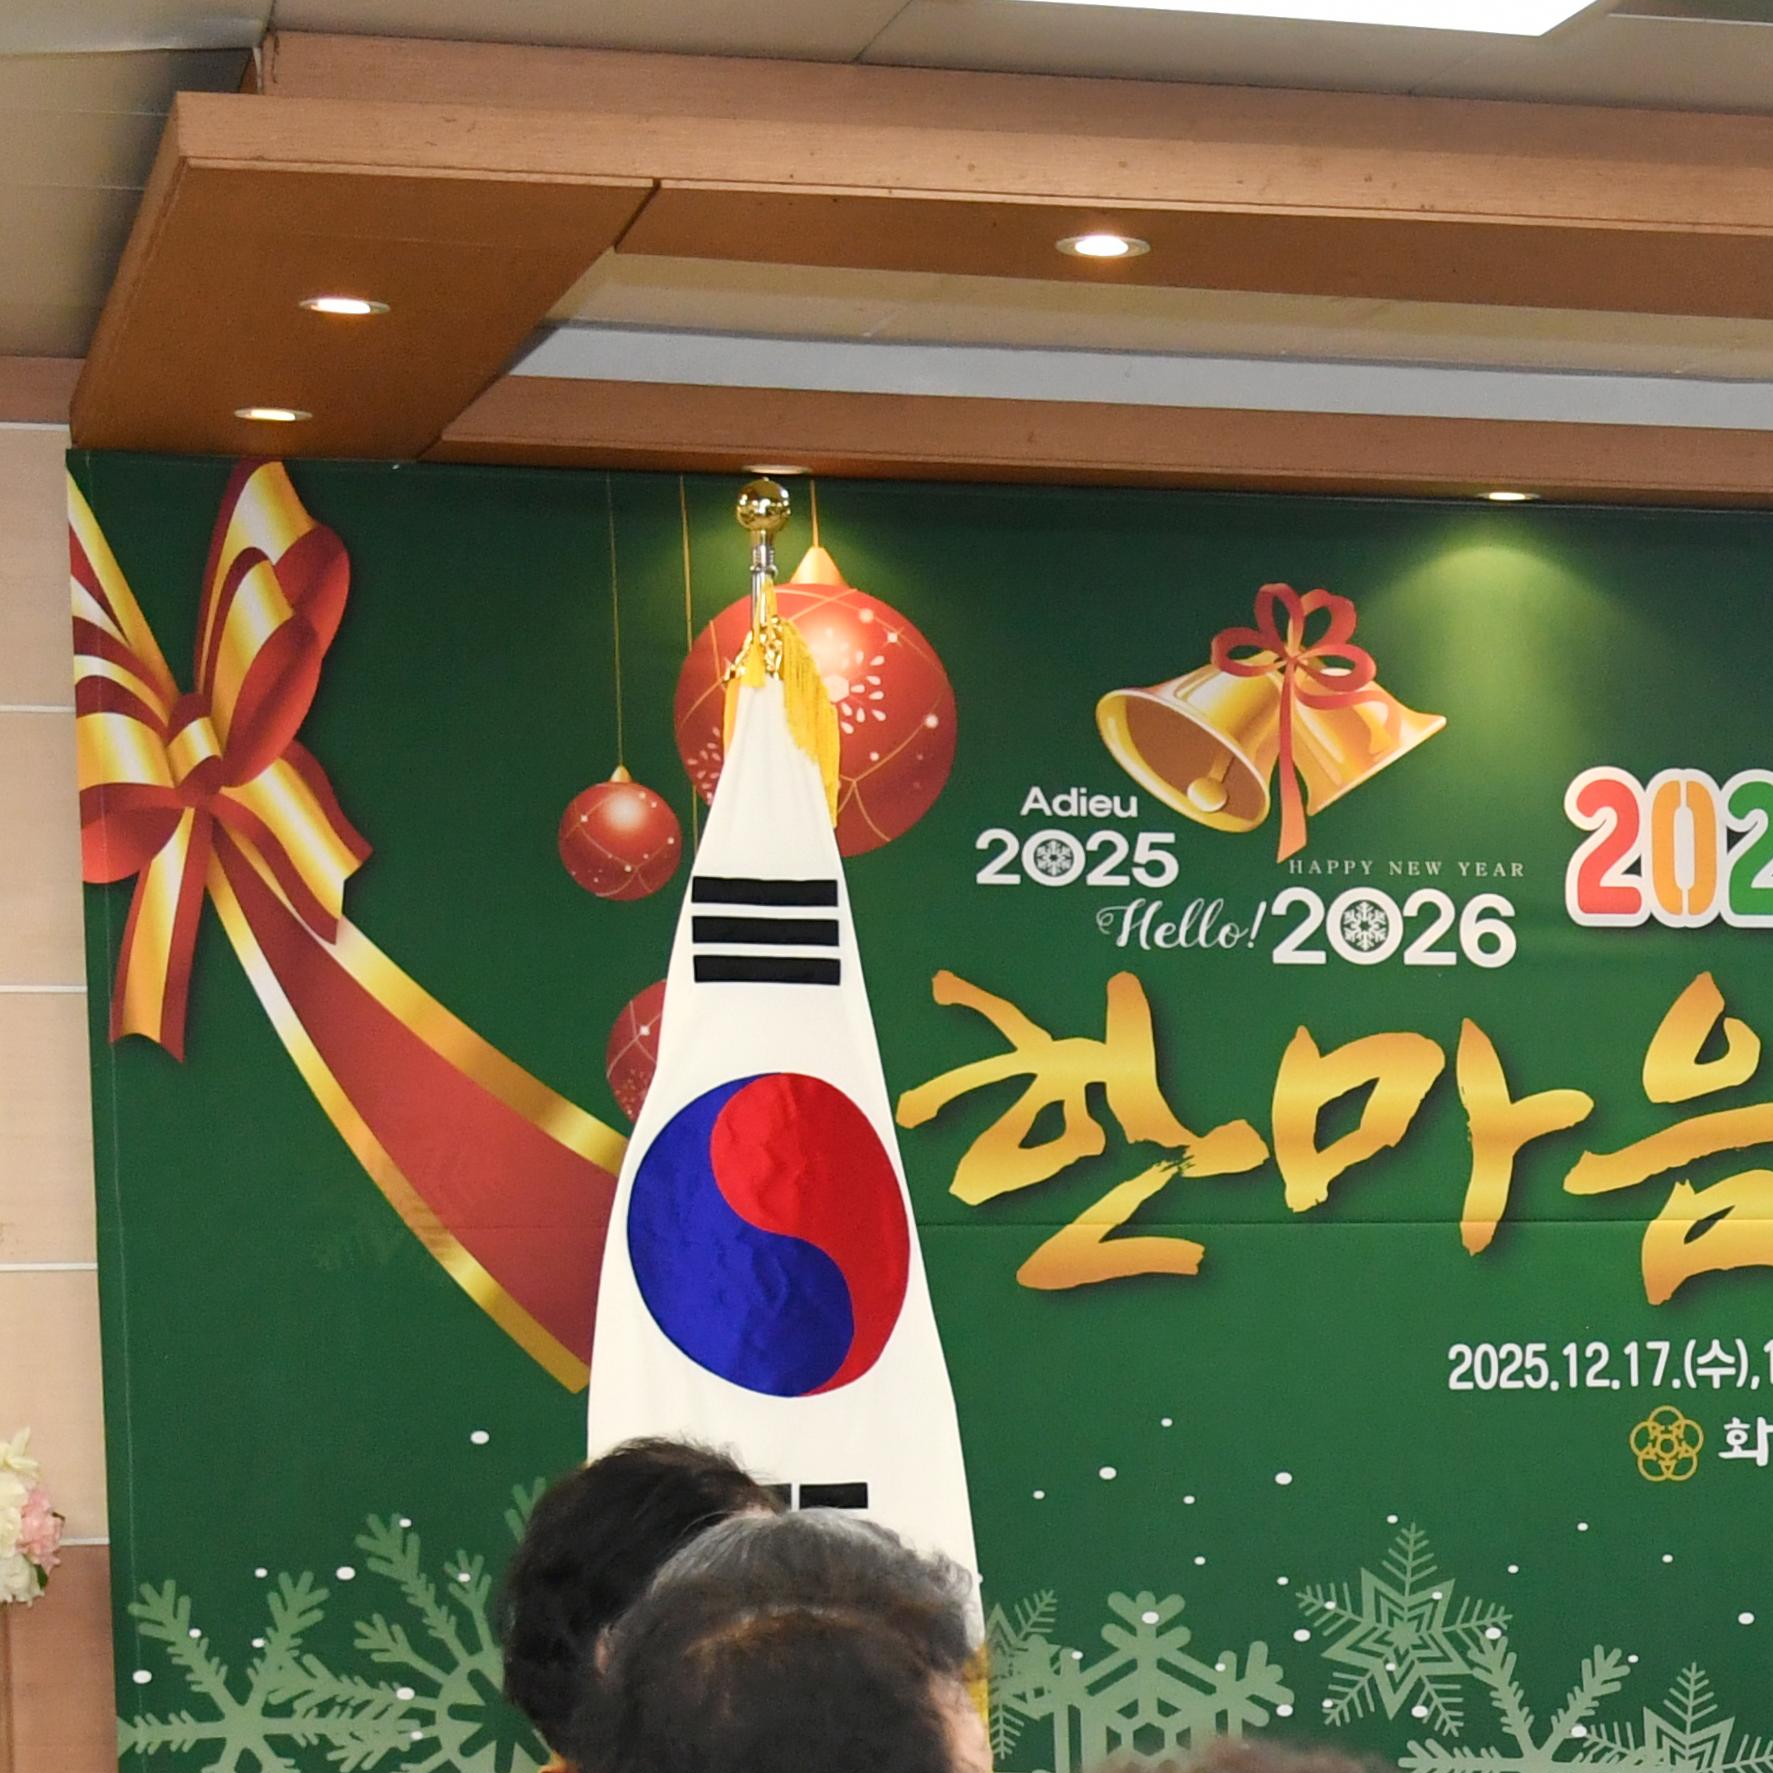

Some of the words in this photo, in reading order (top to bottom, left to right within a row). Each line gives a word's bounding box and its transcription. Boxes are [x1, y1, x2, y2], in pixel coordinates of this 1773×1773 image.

[1020, 786, 1138, 818] Adieu
[975, 828, 1180, 888] 2025
[1288, 859, 1374, 876] HAPPY
[1389, 861, 1443, 877] NEW
[1458, 861, 1525, 878] YEAR
[1096, 898, 1268, 950] Hello!
[1271, 886, 1517, 969] 2026
